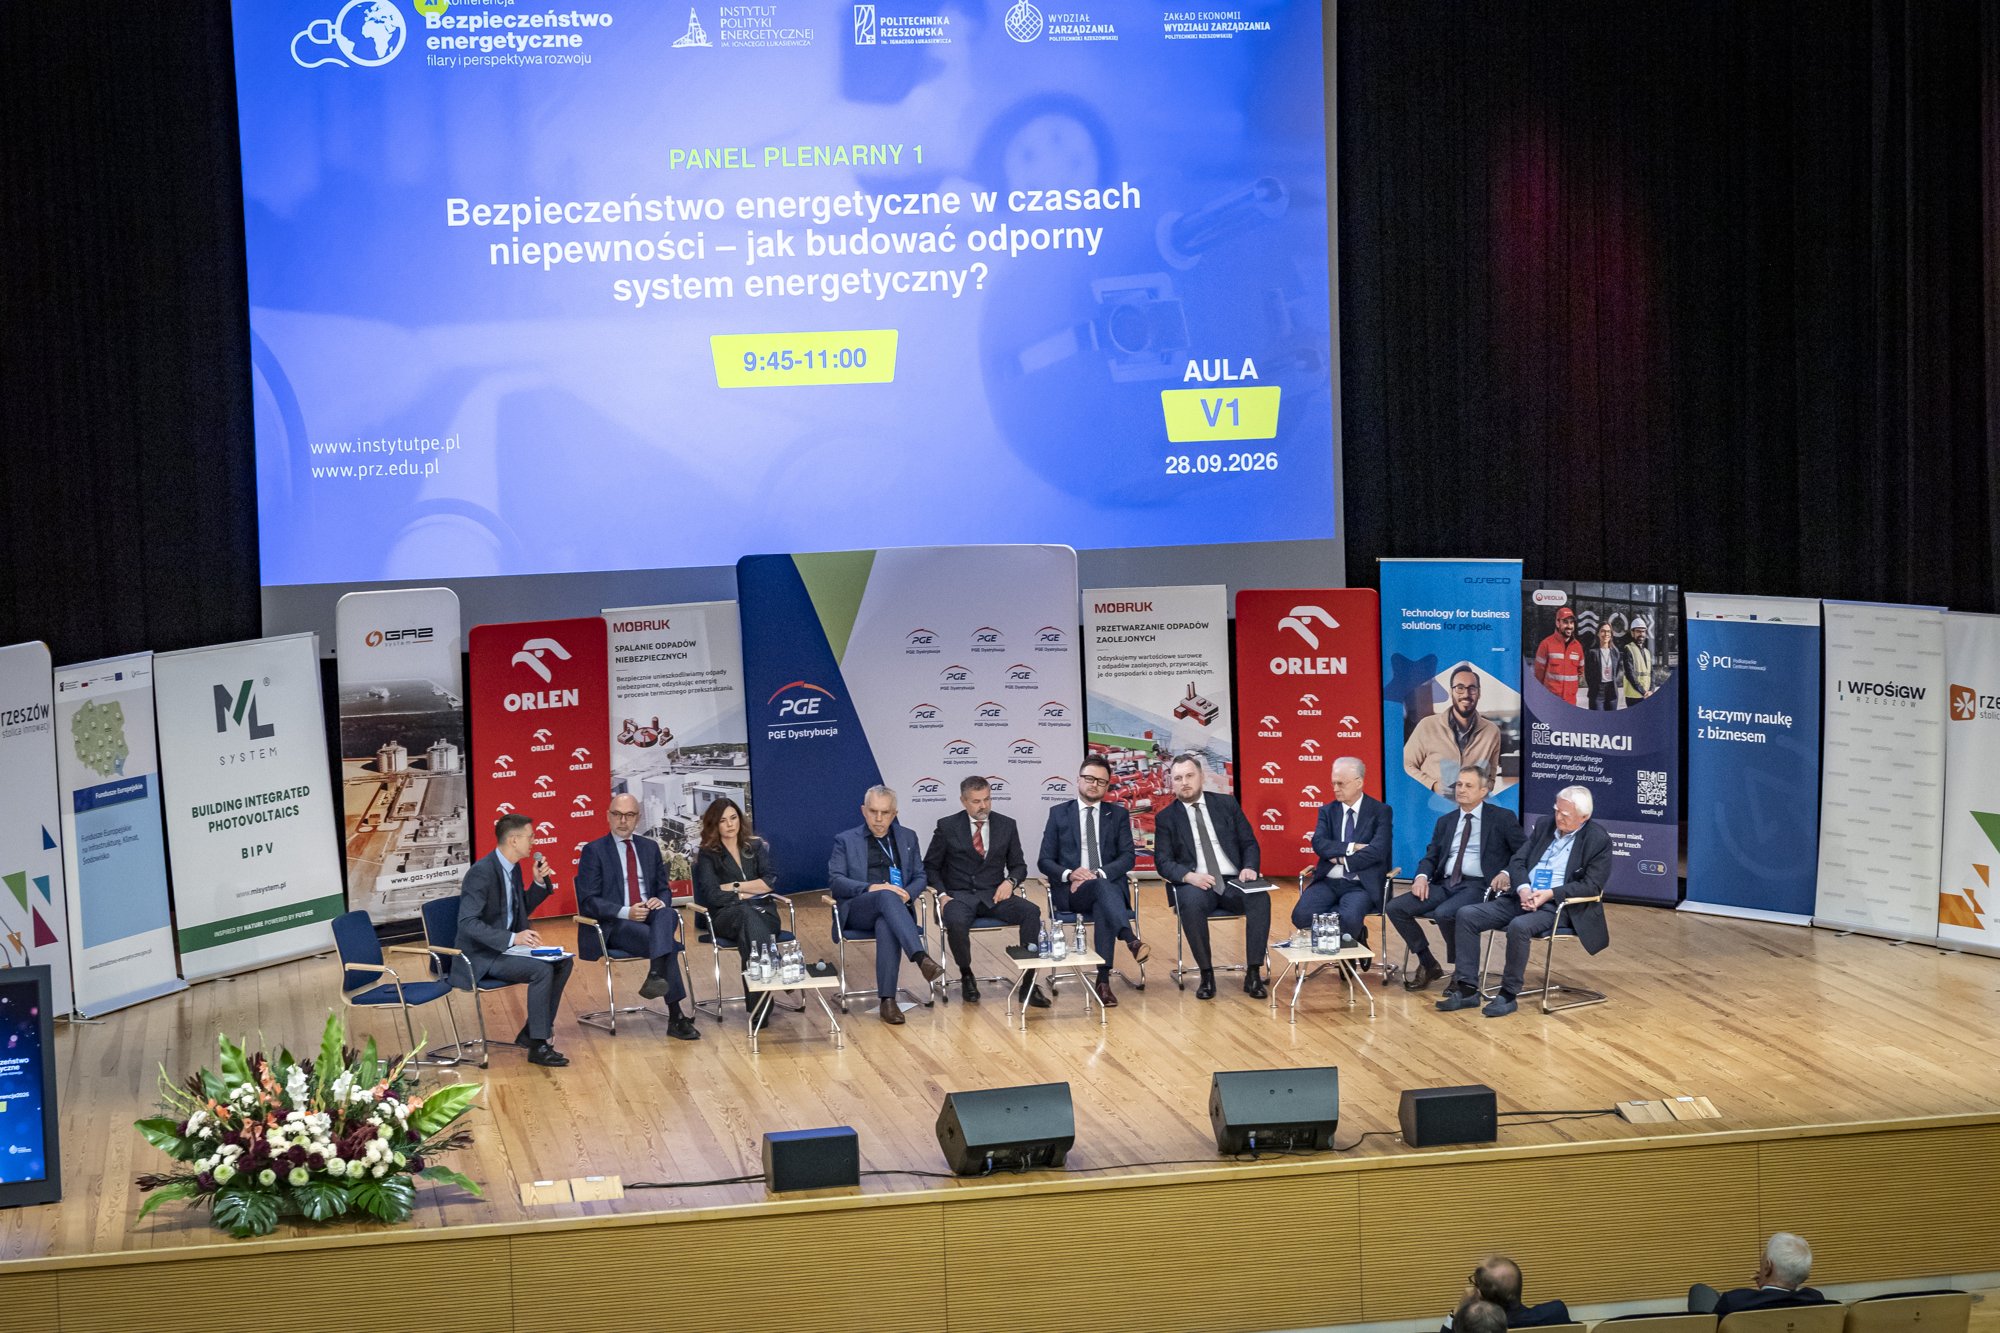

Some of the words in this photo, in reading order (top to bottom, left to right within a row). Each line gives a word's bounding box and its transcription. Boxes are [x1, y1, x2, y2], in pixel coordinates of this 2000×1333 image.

[720, 6, 776, 16] INSTYTUT
[1164, 12, 1195, 20] ZAKŁAD
[1198, 11, 1240, 20] EKONOMII
[425, 10, 613, 32] Bezpieczeństwo
[720, 18, 772, 28] POLITYKI
[880, 16, 950, 26] POLITECHNIKA
[1048, 14, 1090, 23] WYDZIAŁ
[880, 27, 943, 37] RZESZOWSKA
[1048, 24, 1114, 36] ZARZĄDZANIA
[1164, 23, 1208, 31] WYDZIAŁU
[1211, 22, 1270, 33] ZARZĄDZANIA
[721, 28, 814, 40] ENERGETYCZNEJ
[426, 32, 582, 52] energetyczne
[427, 54, 457, 68] filary
[463, 53, 542, 67] perspektywa
[544, 52, 592, 66] rozwoju
[669, 147, 756, 169] PANEL
[764, 144, 904, 168] PLENARNY
[913, 144, 923, 164] 1
[447, 193, 725, 232] Bezpieczeństwo
[736, 190, 960, 224] energetyczne
[971, 191, 998, 213] w
[1008, 182, 1141, 212] czasach
[490, 231, 704, 271] niepewności
[746, 229, 795, 265] jak
[806, 224, 956, 256] budować
[967, 224, 1103, 257] odporny
[613, 273, 733, 308] system
[745, 262, 988, 302] energetyczny?
[743, 348, 867, 371] 9:45-11:00
[1183, 357, 1259, 382] AULA
[1200, 398, 1239, 427] V1
[310, 433, 460, 455] www.instytutpe.pl
[312, 458, 440, 480] www.prz.edu.pl
[1165, 452, 1278, 474] 28.09.2026
[1094, 602, 1153, 613] MOBRUK
[1401, 608, 1454, 620] Technology
[1456, 609, 1469, 617] for
[1471, 609, 1510, 618] business
[613, 619, 670, 633] MOBRUK
[1096, 623, 1164, 632] PRZETWARZANIE
[1166, 621, 1209, 630] ODPADÓW
[1401, 621, 1441, 630] solutions
[1443, 622, 1457, 630] for
[1459, 622, 1493, 632] people.
[912, 636, 932, 644] PGE
[977, 634, 997, 642] PGE
[1040, 634, 1060, 642] PGE
[1096, 635, 1156, 643] ZAOLEJONYCH
[615, 643, 653, 652] SPALANIE
[655, 639, 696, 649] ODPADÓW
[615, 652, 687, 663] NIEBEZPIECZNYCH
[1097, 655, 1137, 663] Odzyskujemy
[1713, 656, 1731, 668] PCI
[1102, 662, 1130, 670] odpadów
[1270, 657, 1347, 675] ORLEN
[650, 689, 686, 697] termicznego
[1848, 681, 1926, 700] WFOŚiGW
[504, 688, 578, 712] ORLEN
[779, 697, 821, 716] PGE
[1, 703, 49, 726] rzeszów
[1044, 709, 1063, 717] PGE
[1698, 705, 1752, 725] Łączymy
[1754, 711, 1792, 729] naukę
[1532, 722, 1550, 730] GŁOS
[768, 730, 786, 740] PGE
[788, 727, 838, 739] Dystrybucja
[1698, 728, 1704, 738] z
[1707, 725, 1766, 743] biznesem
[1531, 730, 1632, 751] REGENERACJI
[531, 744, 554, 752] ORLEN
[219, 747, 278, 766] SYSTEM
[1532, 751, 1573, 762] Potrzebujemy
[1573, 755, 1603, 764] solidnego
[569, 763, 592, 771] ORLEN
[1531, 761, 1560, 771] dostawcy
[1587, 765, 1604, 774] który
[492, 770, 516, 779] ORLEN
[1532, 771, 1557, 779] zapewni
[1557, 773, 1575, 782] pełny
[1576, 774, 1594, 782] zakres
[990, 783, 1003, 791] GE
[1047, 783, 1067, 791] PGE
[532, 790, 556, 799] ORLEN
[192, 799, 242, 818] BUILDING
[245, 785, 310, 808] INTEGRATED
[209, 805, 300, 833] PHOTOVOLTAICS
[571, 810, 594, 818] ORLEN
[534, 837, 557, 845] ORLEN
[241, 842, 273, 859] BIPV
[391, 868, 459, 884] www.gaz-system.pl
[244, 921, 264, 930] NATURE
[295, 909, 314, 918] FUTURE
